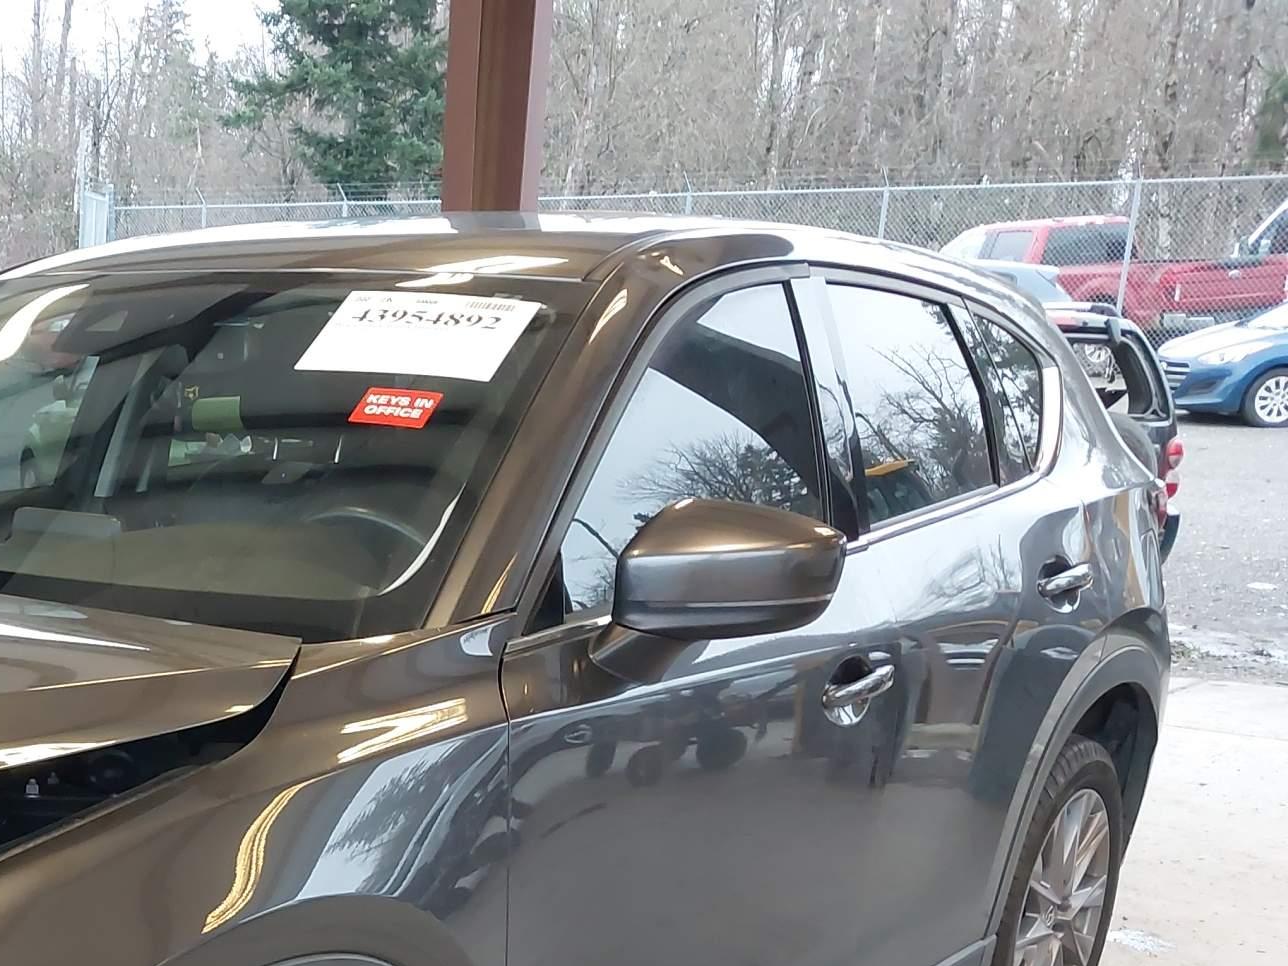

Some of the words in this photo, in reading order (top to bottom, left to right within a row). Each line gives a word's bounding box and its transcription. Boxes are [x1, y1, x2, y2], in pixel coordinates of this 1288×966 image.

[351, 308, 503, 330] 43954892
[366, 394, 411, 407] KEYS
[414, 397, 434, 409] IN
[364, 405, 424, 419] OFFICE
